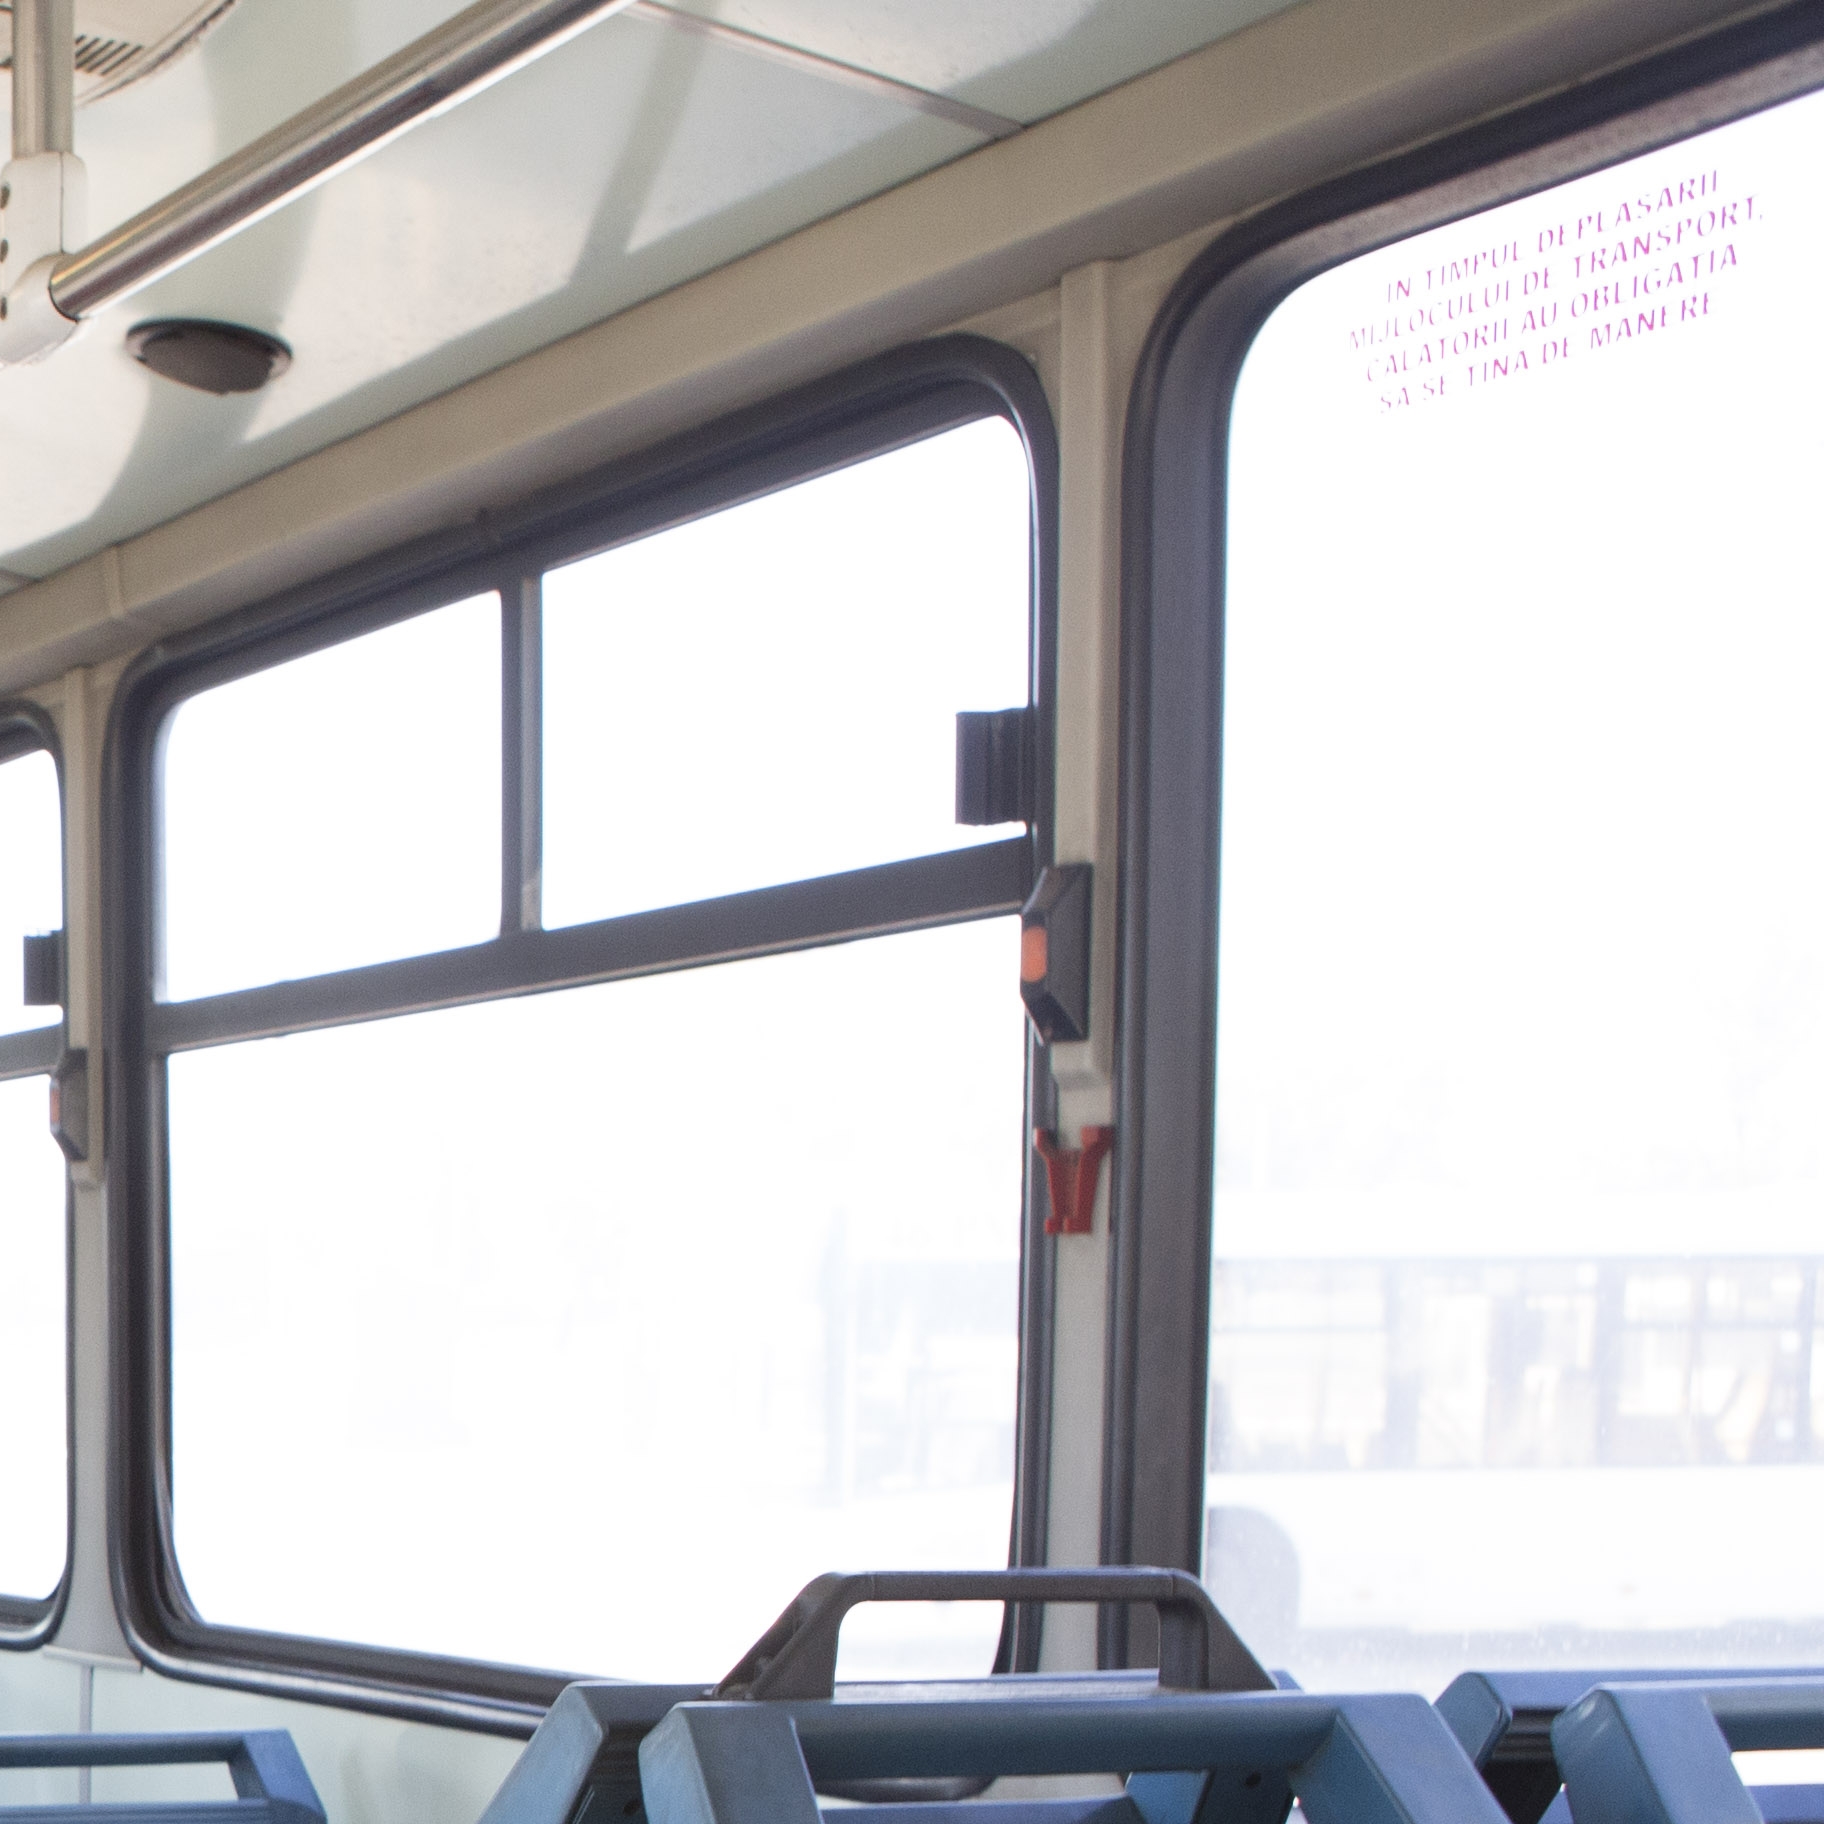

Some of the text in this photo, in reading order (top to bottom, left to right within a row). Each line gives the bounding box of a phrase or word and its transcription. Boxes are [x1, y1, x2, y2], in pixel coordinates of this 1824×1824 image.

[1349, 281, 1509, 352] MIJLOCULUI
[1523, 267, 1551, 295] DE
[1367, 243, 1737, 382] CALATORII AU OBLIGATIA
[1388, 278, 1411, 303] IN
[1427, 241, 1520, 290] TIMPUL
[1379, 292, 1713, 414] SA SE TINA DE MANERE
